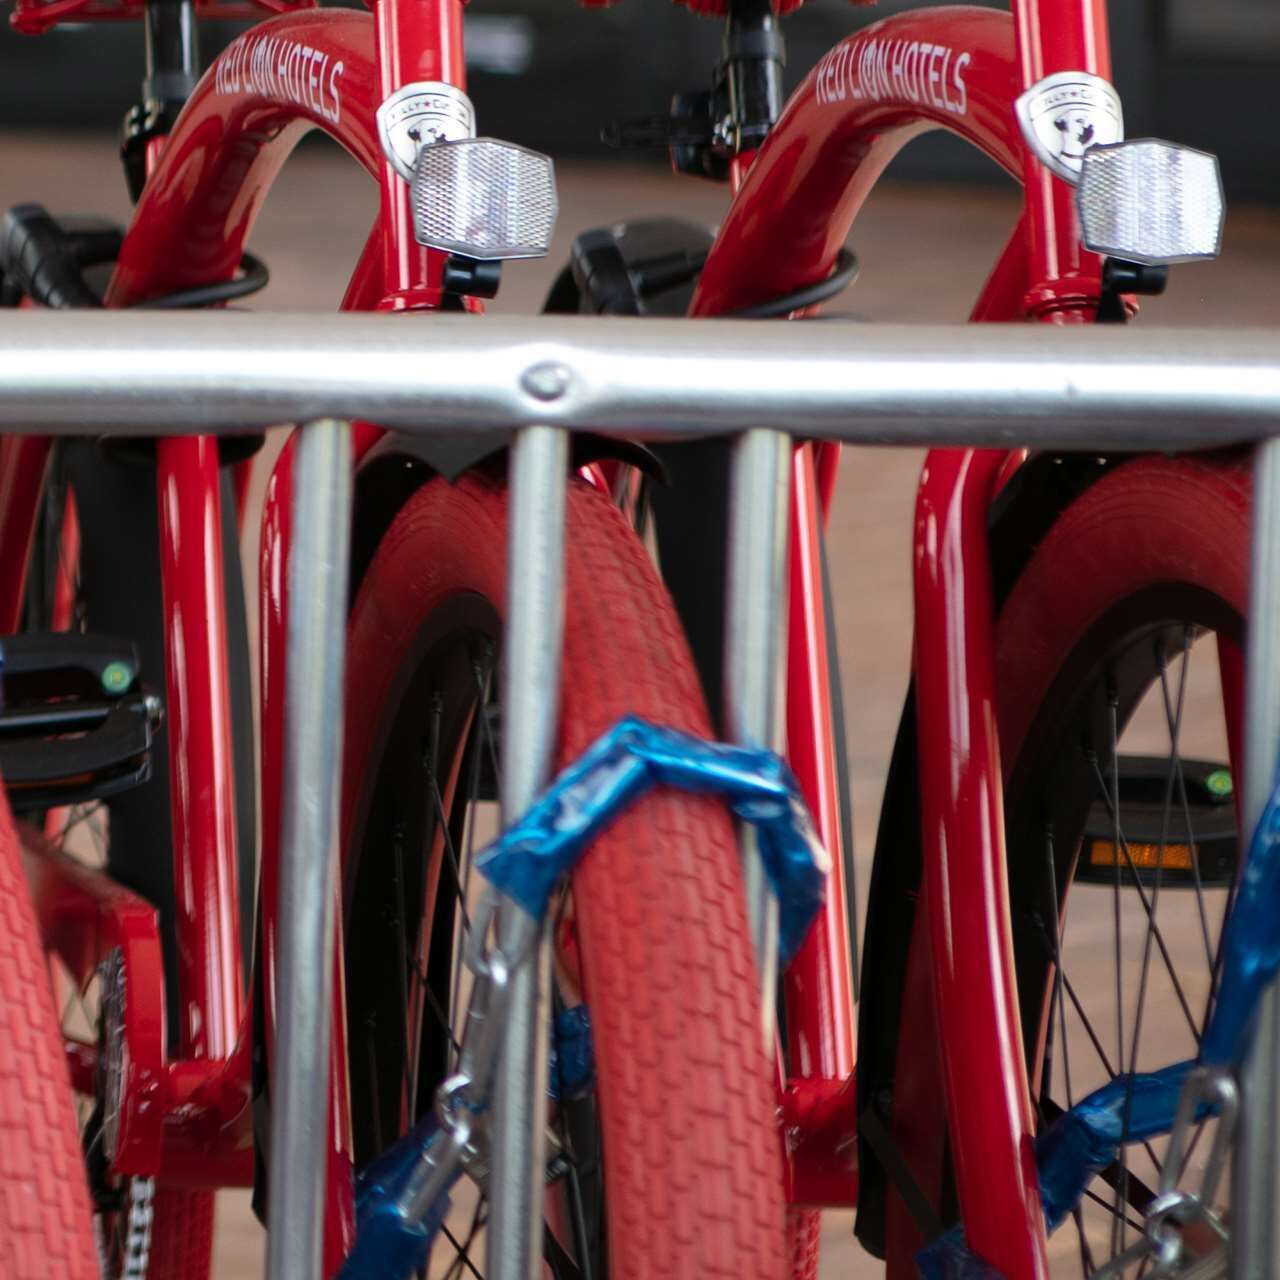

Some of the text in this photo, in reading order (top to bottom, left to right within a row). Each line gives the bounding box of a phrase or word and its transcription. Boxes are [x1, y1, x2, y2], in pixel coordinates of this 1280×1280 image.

[215, 34, 344, 124] RED LION HOTELS
[815, 37, 972, 116] RED LION HOTELS
